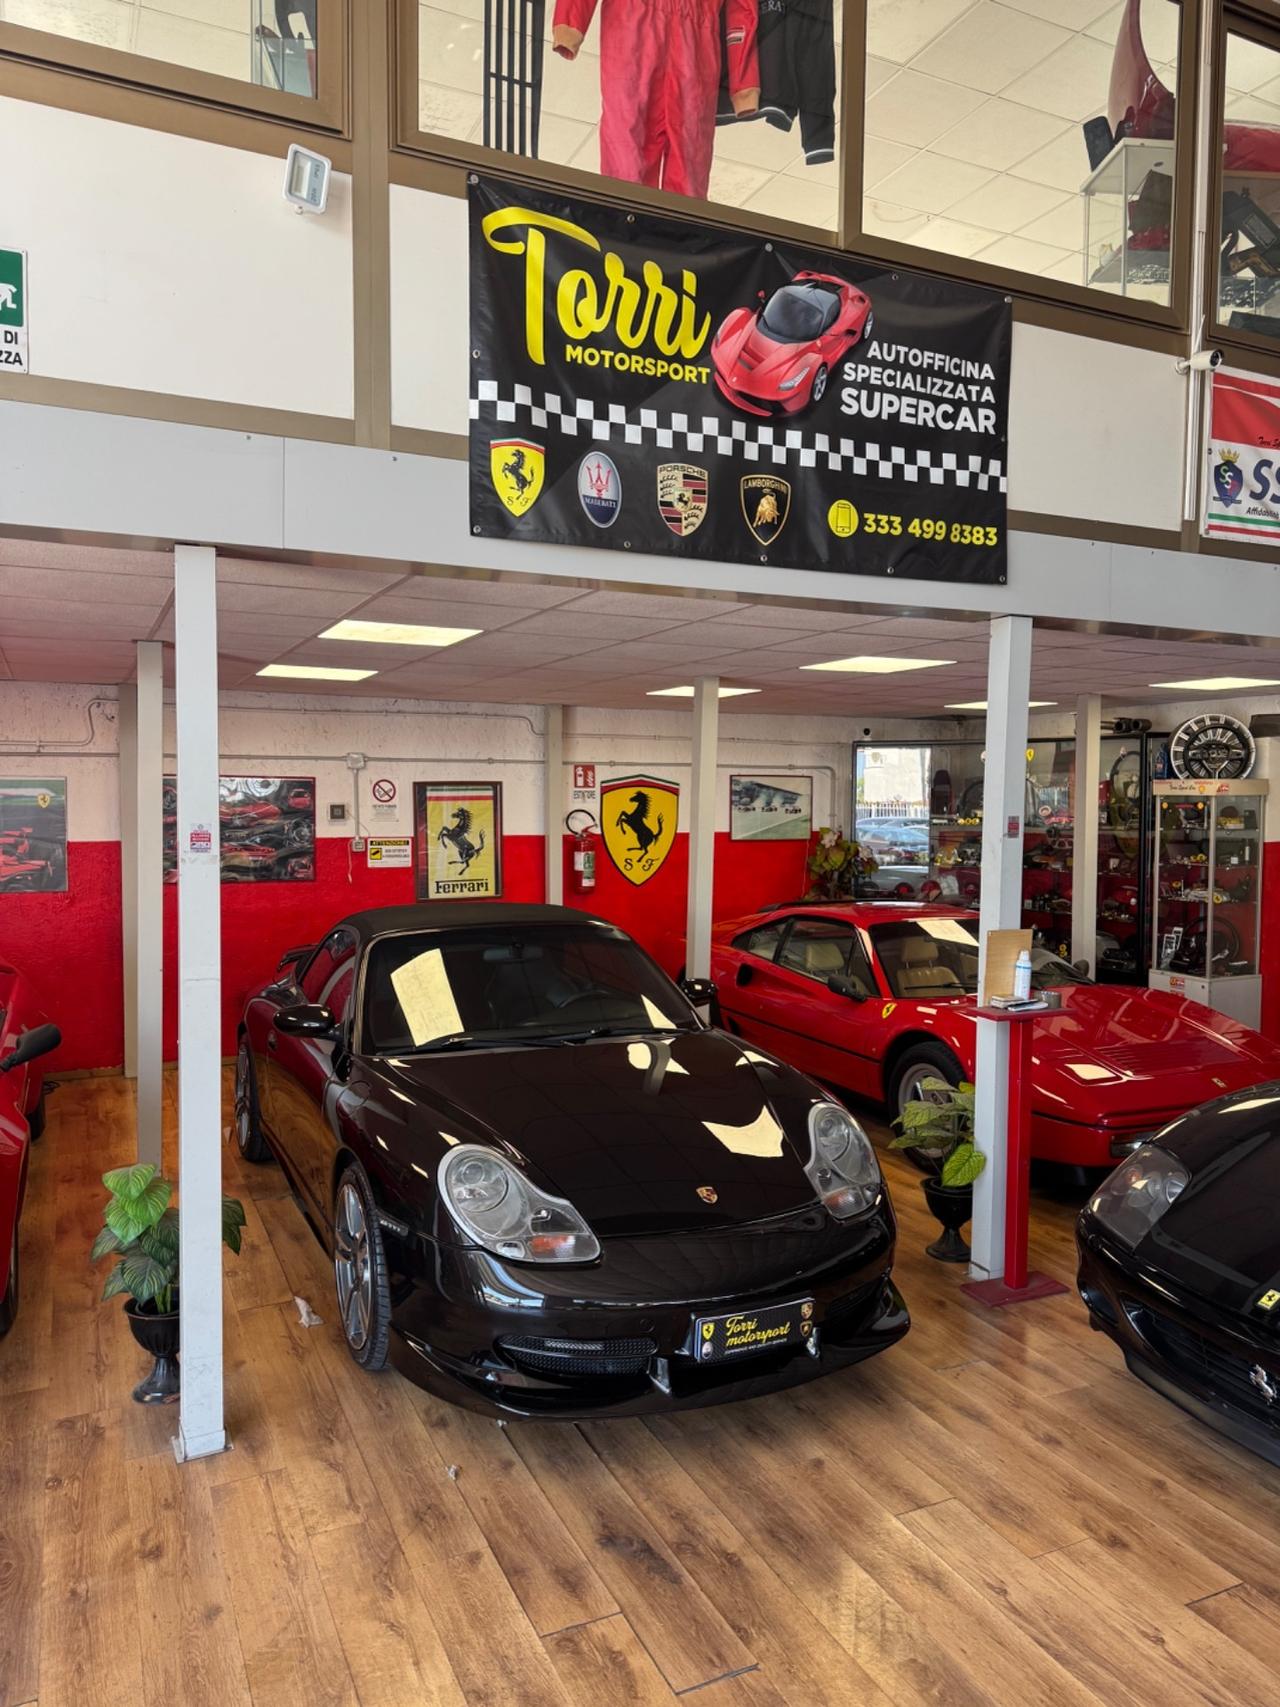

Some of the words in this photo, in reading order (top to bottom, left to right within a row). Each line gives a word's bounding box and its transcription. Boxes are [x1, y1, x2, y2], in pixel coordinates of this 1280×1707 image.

[482, 206, 712, 366] Torri
[4, 330, 18, 345] DI
[565, 344, 711, 385] MOTORSPORT
[866, 340, 996, 381] AUTOFFICINA
[842, 361, 996, 404] SPECIALIZZATA
[839, 386, 997, 435] SUPERCAR
[659, 465, 706, 478] PORSCHE
[744, 479, 787, 493] LAMBORGHINI
[584, 497, 617, 508] MASERATI
[863, 512, 903, 536] 333
[908, 518, 947, 540] 499
[950, 523, 998, 546] 8383
[624, 858, 633, 871] S
[435, 878, 489, 894] Ferrari
[725, 1315, 758, 1336] Torri
[726, 1321, 791, 1347] motorsport
